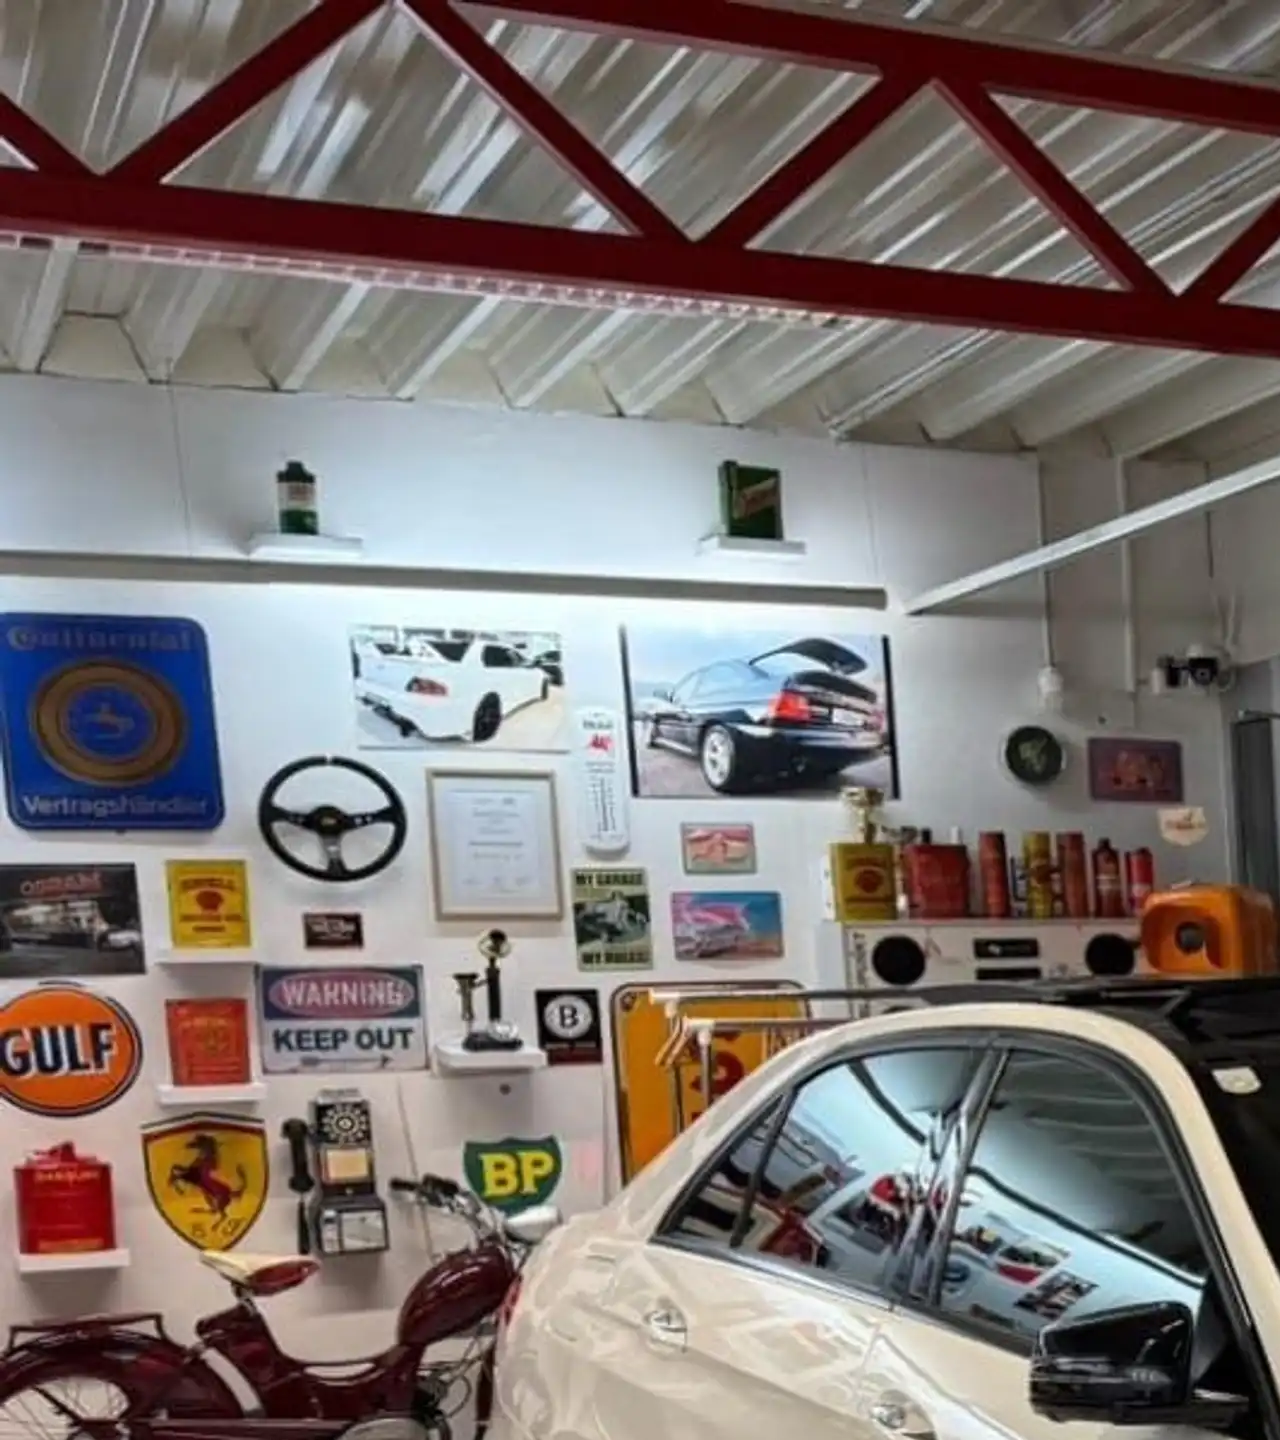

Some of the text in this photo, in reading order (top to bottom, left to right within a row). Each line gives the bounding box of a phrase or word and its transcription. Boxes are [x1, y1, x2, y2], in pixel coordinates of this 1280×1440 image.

[283, 980, 405, 1007] WARNING
[0, 1023, 115, 1079] GULF
[273, 1027, 414, 1050] KEEP OUT
[480, 1150, 554, 1196] BP
